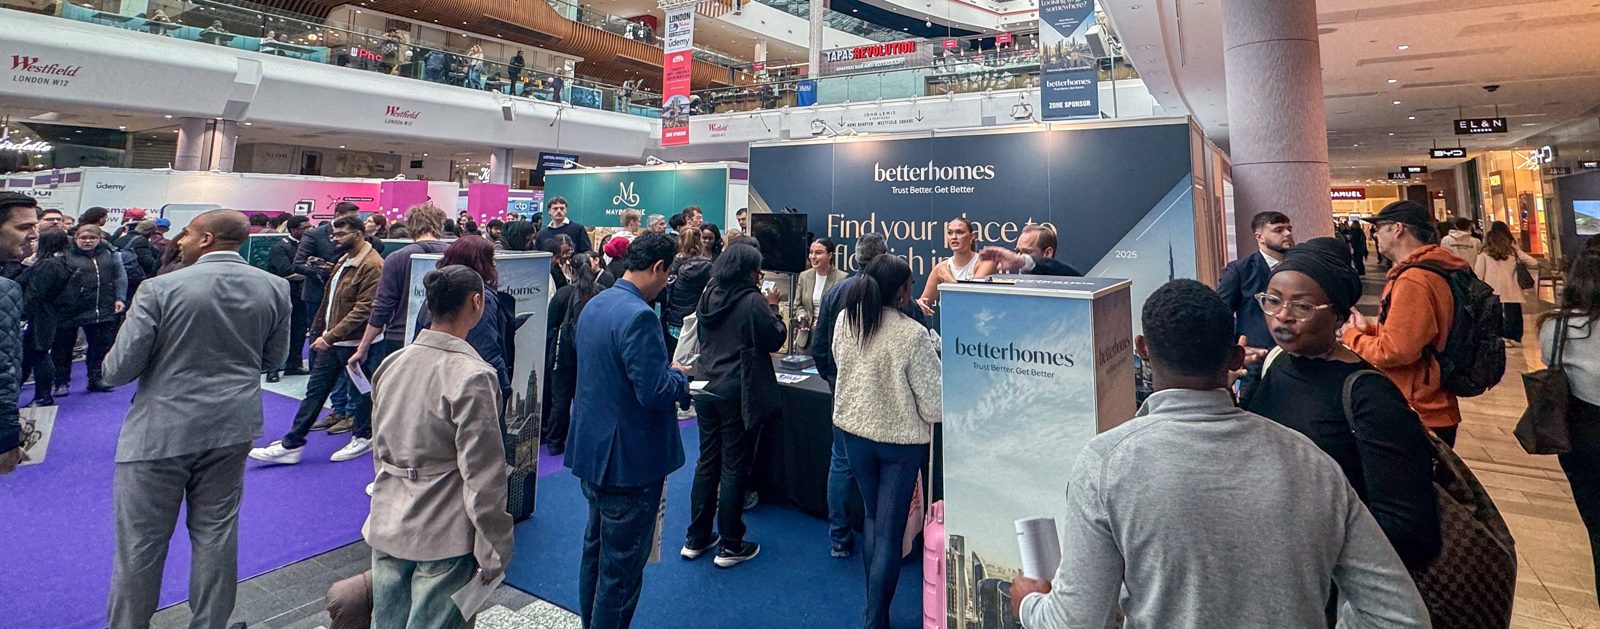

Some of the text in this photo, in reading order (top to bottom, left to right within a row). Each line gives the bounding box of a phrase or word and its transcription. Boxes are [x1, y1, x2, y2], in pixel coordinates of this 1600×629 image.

[669, 12, 691, 23] LONDON
[10, 55, 82, 77] Westfield
[13, 75, 50, 85] LONDON
[1046, 78, 1091, 87] betterhomes
[1064, 100, 1091, 108] SPONSOR
[385, 106, 421, 119] Westfield
[874, 160, 995, 182] betterhomes
[891, 185, 974, 194] Trust Better. Get Better
[827, 212, 875, 239] Find
[880, 220, 938, 242] your
[1115, 250, 1137, 259] 2025
[955, 337, 1075, 367] betterhomes
[972, 361, 1055, 379] Trust Better. Get Better
